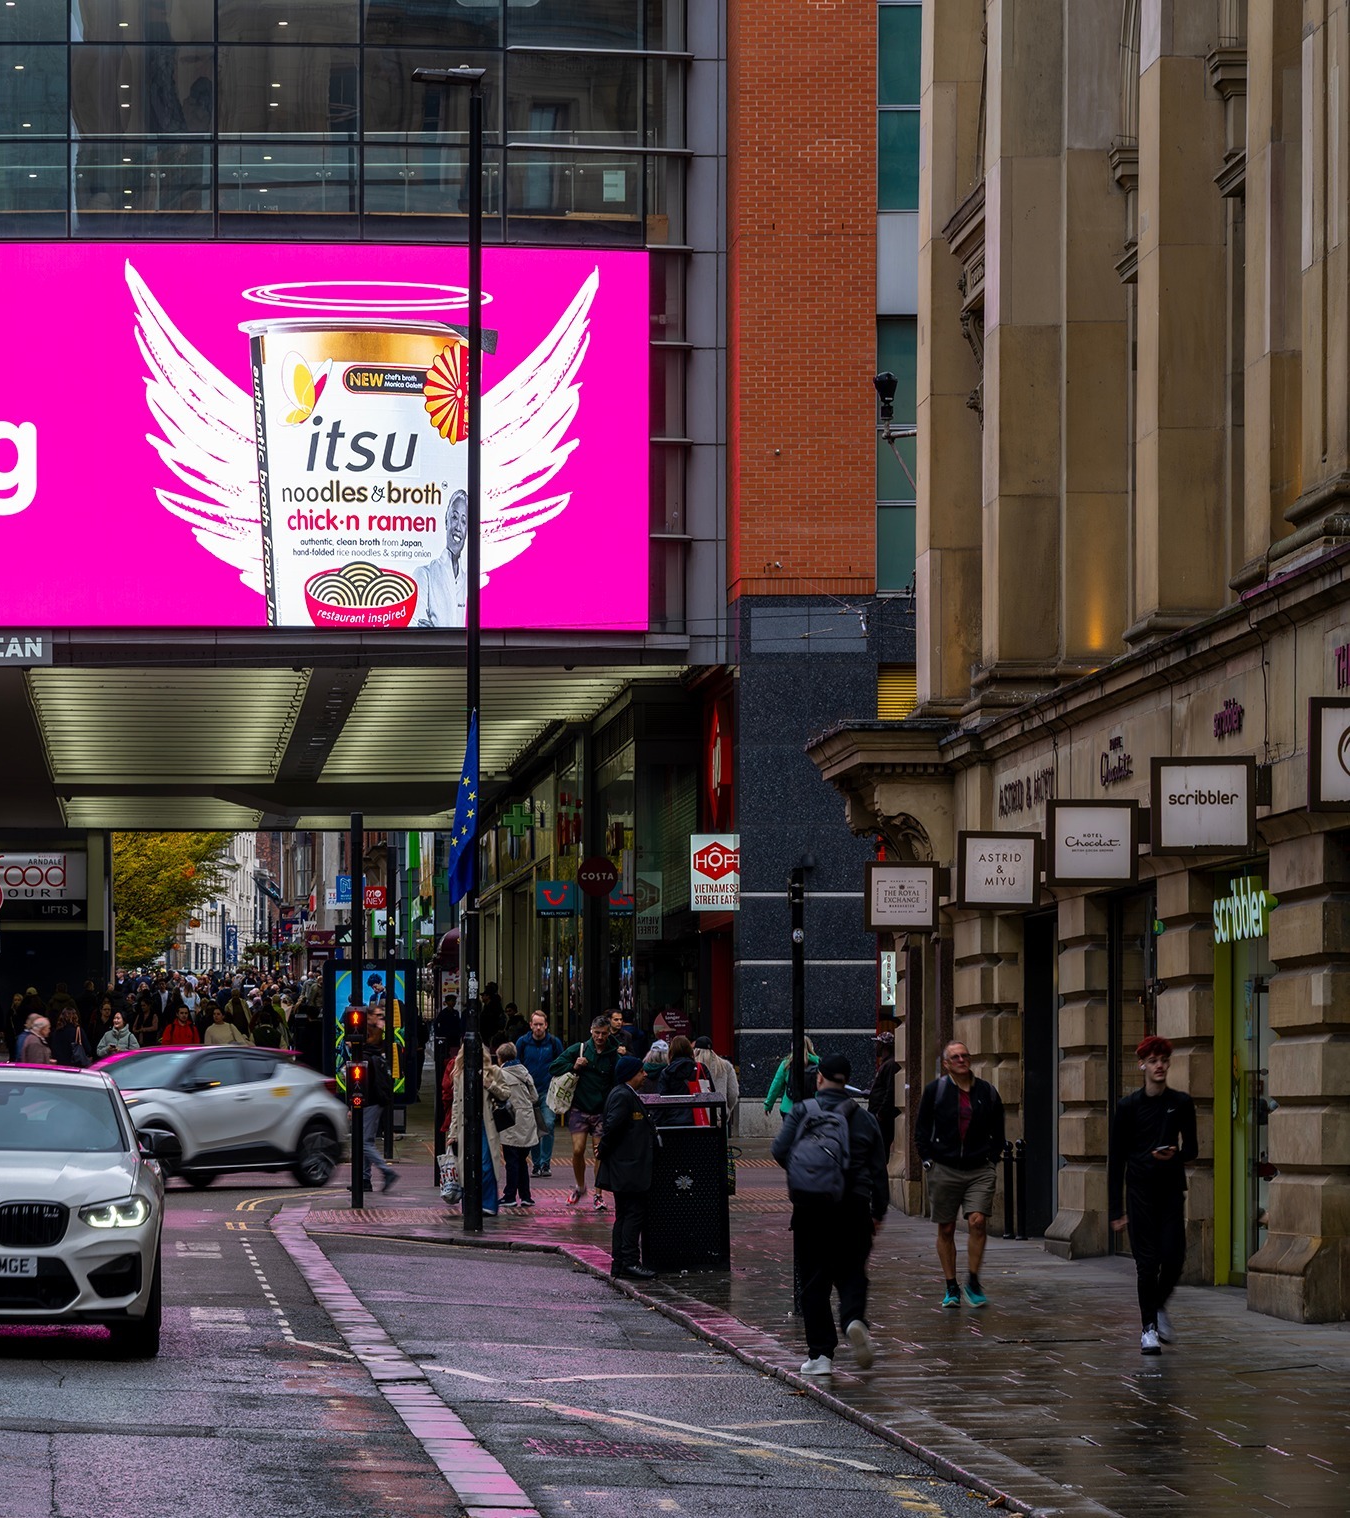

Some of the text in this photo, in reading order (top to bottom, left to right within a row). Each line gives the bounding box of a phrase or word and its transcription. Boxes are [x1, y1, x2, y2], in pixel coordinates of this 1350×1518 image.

[349, 371, 385, 388] NEW
[402, 374, 417, 382] broth
[252, 366, 266, 463] authentic
[306, 415, 419, 473] itsu
[258, 467, 270, 527] broth
[282, 480, 369, 504] noodles
[386, 480, 442, 505] broth
[368, 514, 437, 533] ramen
[336, 538, 357, 546] clean
[359, 538, 380, 546] broth
[382, 538, 399, 547] from
[292, 548, 432, 560] hand-folded rice noodles & spring onion
[262, 536, 274, 589] from
[316, 606, 407, 625] restaurant inspired
[1168, 790, 1239, 806] scribbler
[28, 858, 62, 866] ARNDALE
[978, 853, 1022, 862] ASTRID
[996, 865, 1004, 874] &
[580, 872, 614, 882] COSTA
[984, 877, 1016, 886] MIYU
[7, 888, 67, 898] OURT
[694, 895, 719, 905] STREET
[41, 905, 69, 914] LIFTS
[1213, 875, 1266, 944] scribbler
